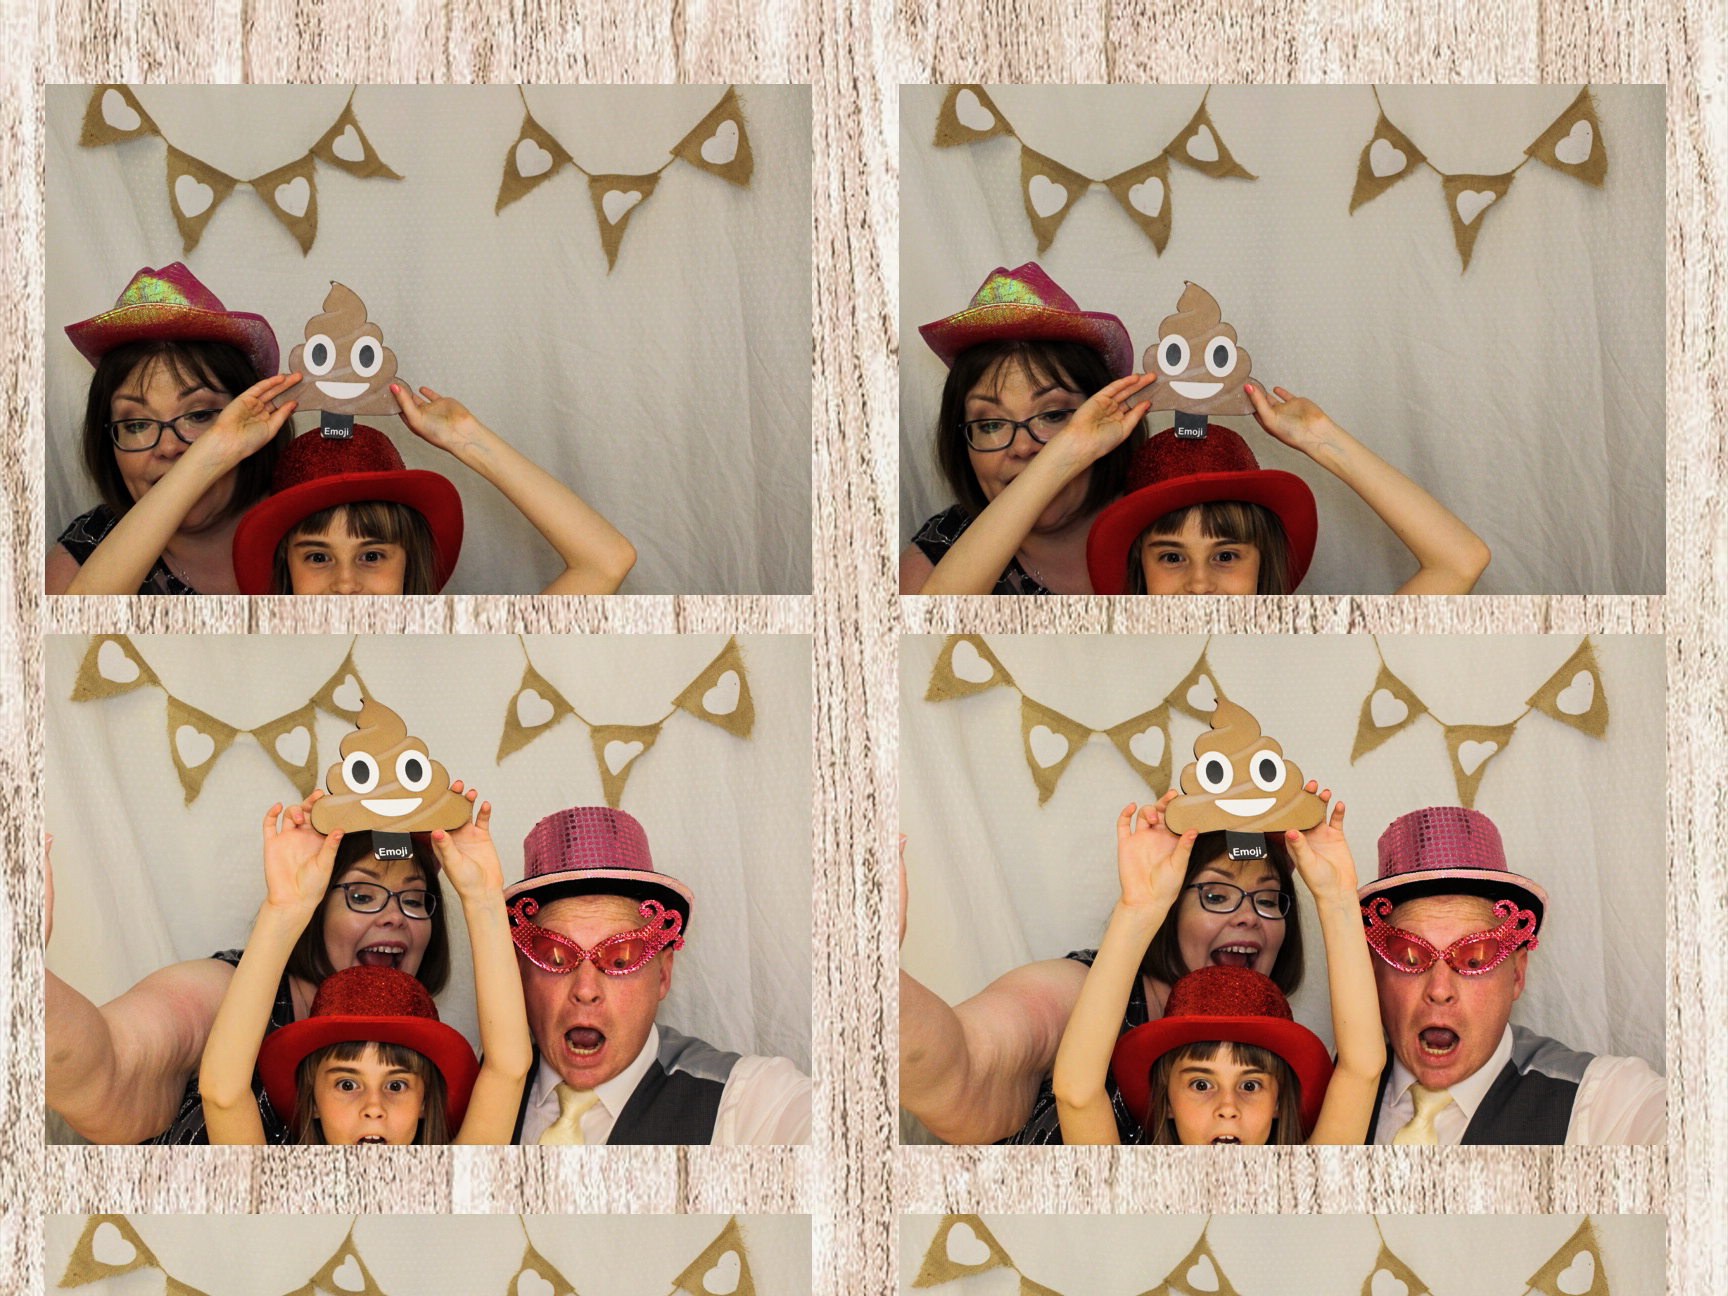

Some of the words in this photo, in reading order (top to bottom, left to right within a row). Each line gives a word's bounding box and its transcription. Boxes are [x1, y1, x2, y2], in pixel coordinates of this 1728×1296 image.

[324, 427, 349, 438] Emoji
[1178, 427, 1203, 438] Emoji
[378, 847, 408, 858] Emoji
[1232, 847, 1262, 858] Emoji
